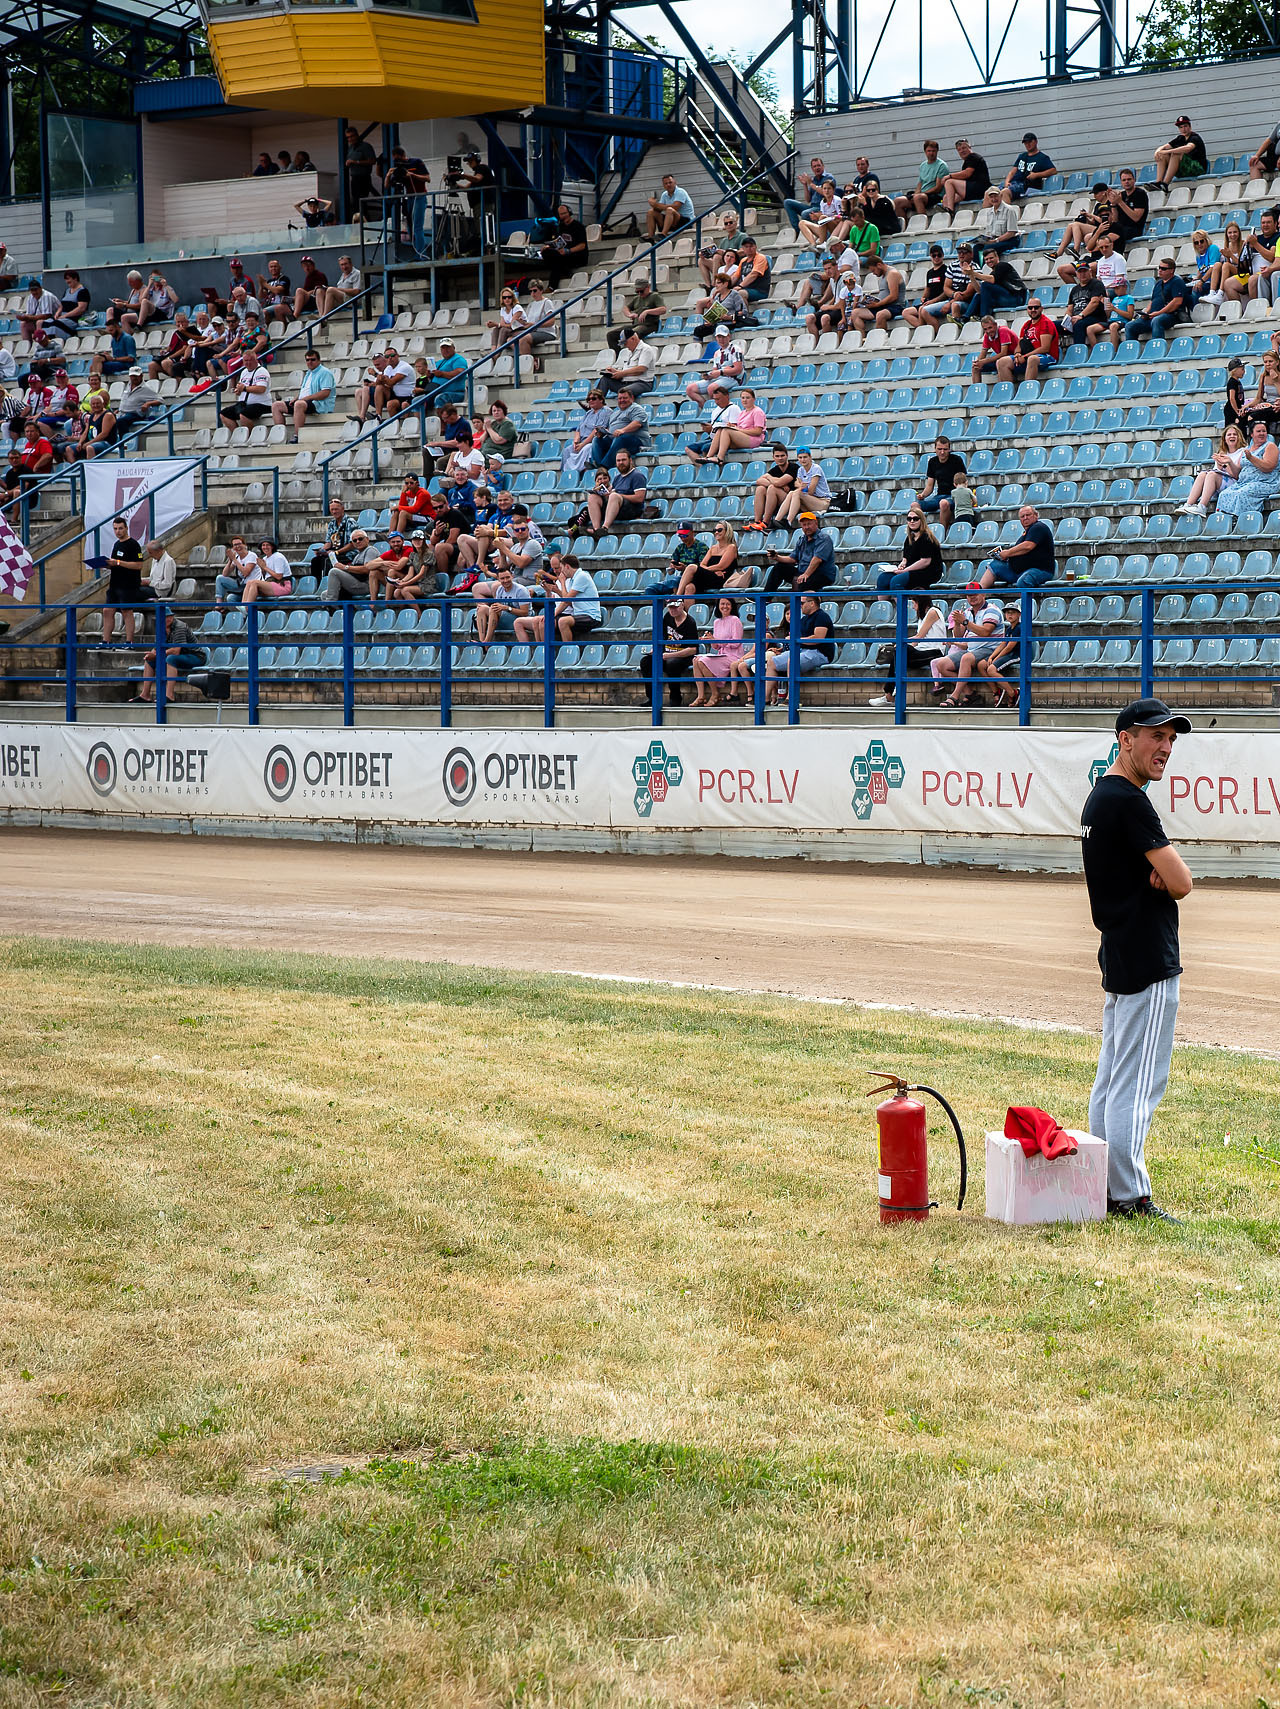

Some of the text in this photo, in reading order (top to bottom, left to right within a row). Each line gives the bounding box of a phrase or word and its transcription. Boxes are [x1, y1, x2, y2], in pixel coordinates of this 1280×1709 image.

[123, 747, 208, 783] OPTIBET
[303, 750, 393, 787] OPTIBET
[484, 752, 578, 790] OPTIBET
[124, 786, 169, 794] SPORTA
[303, 789, 353, 799] SPORTA
[484, 792, 537, 803] SPORTA
[699, 769, 799, 804] PCR.LV
[922, 770, 1033, 808] PCR.LV
